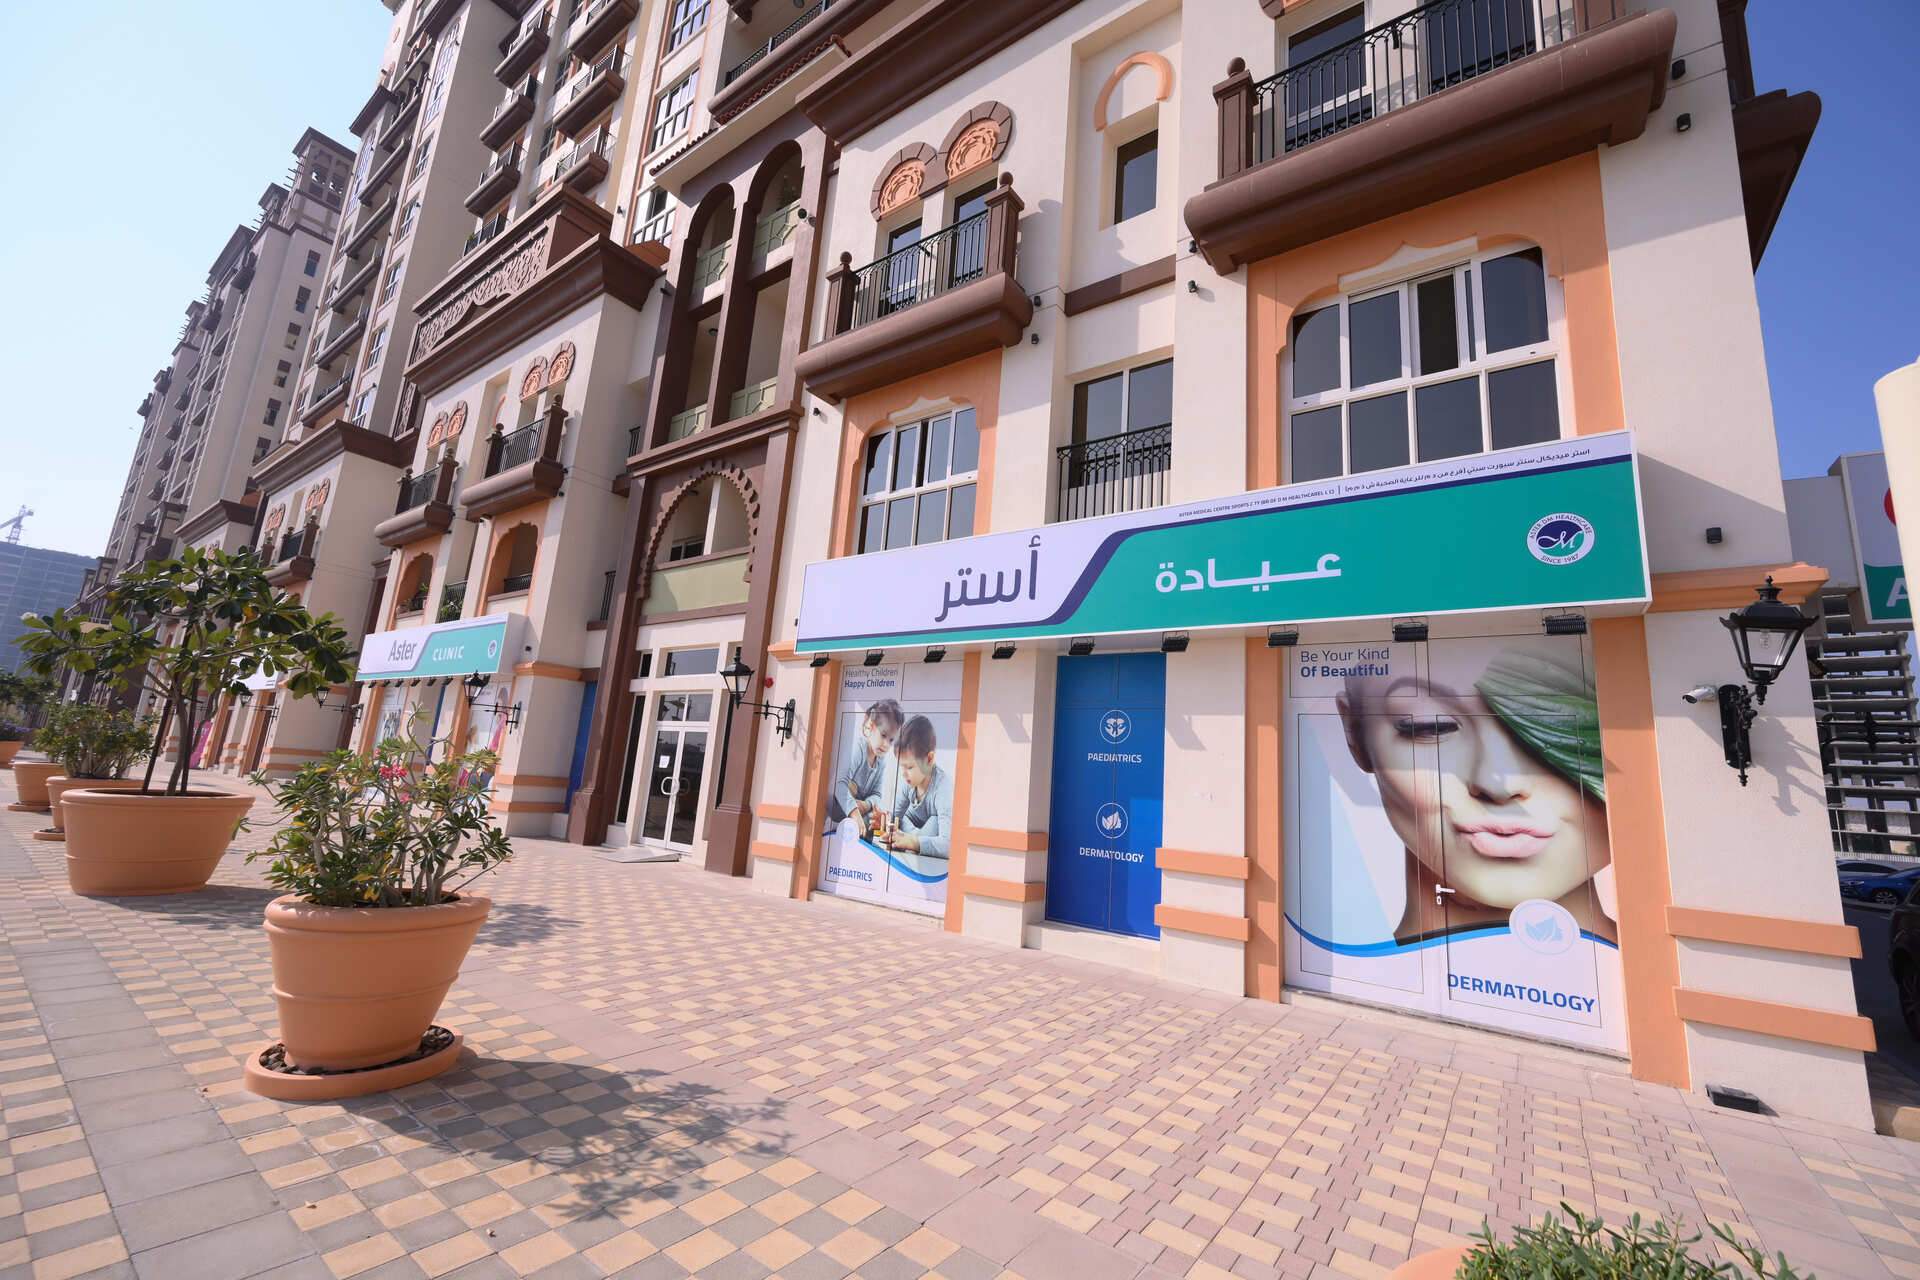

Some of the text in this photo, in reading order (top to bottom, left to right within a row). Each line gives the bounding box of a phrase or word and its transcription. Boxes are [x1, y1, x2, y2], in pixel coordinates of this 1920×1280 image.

[1555, 514, 1593, 534] HEALTHCARE
[1541, 555, 1561, 563] SINCE
[934, 534, 1041, 622] أستر
[1155, 553, 1342, 592] عيادة
[388, 640, 418, 662] Aster
[432, 645, 465, 662] CLINIC
[1300, 648, 1390, 662] Be Your Kind
[846, 667, 898, 678] Healthy Children
[1300, 664, 1388, 678] Of Beautiful
[844, 679, 895, 689] Happy Children
[1087, 752, 1142, 763] PAEDIATRICS
[1079, 847, 1144, 863] DERMATOLOGY
[828, 866, 872, 882] PAEDIATRICS
[1448, 973, 1595, 1013] DERMATOLOGY
